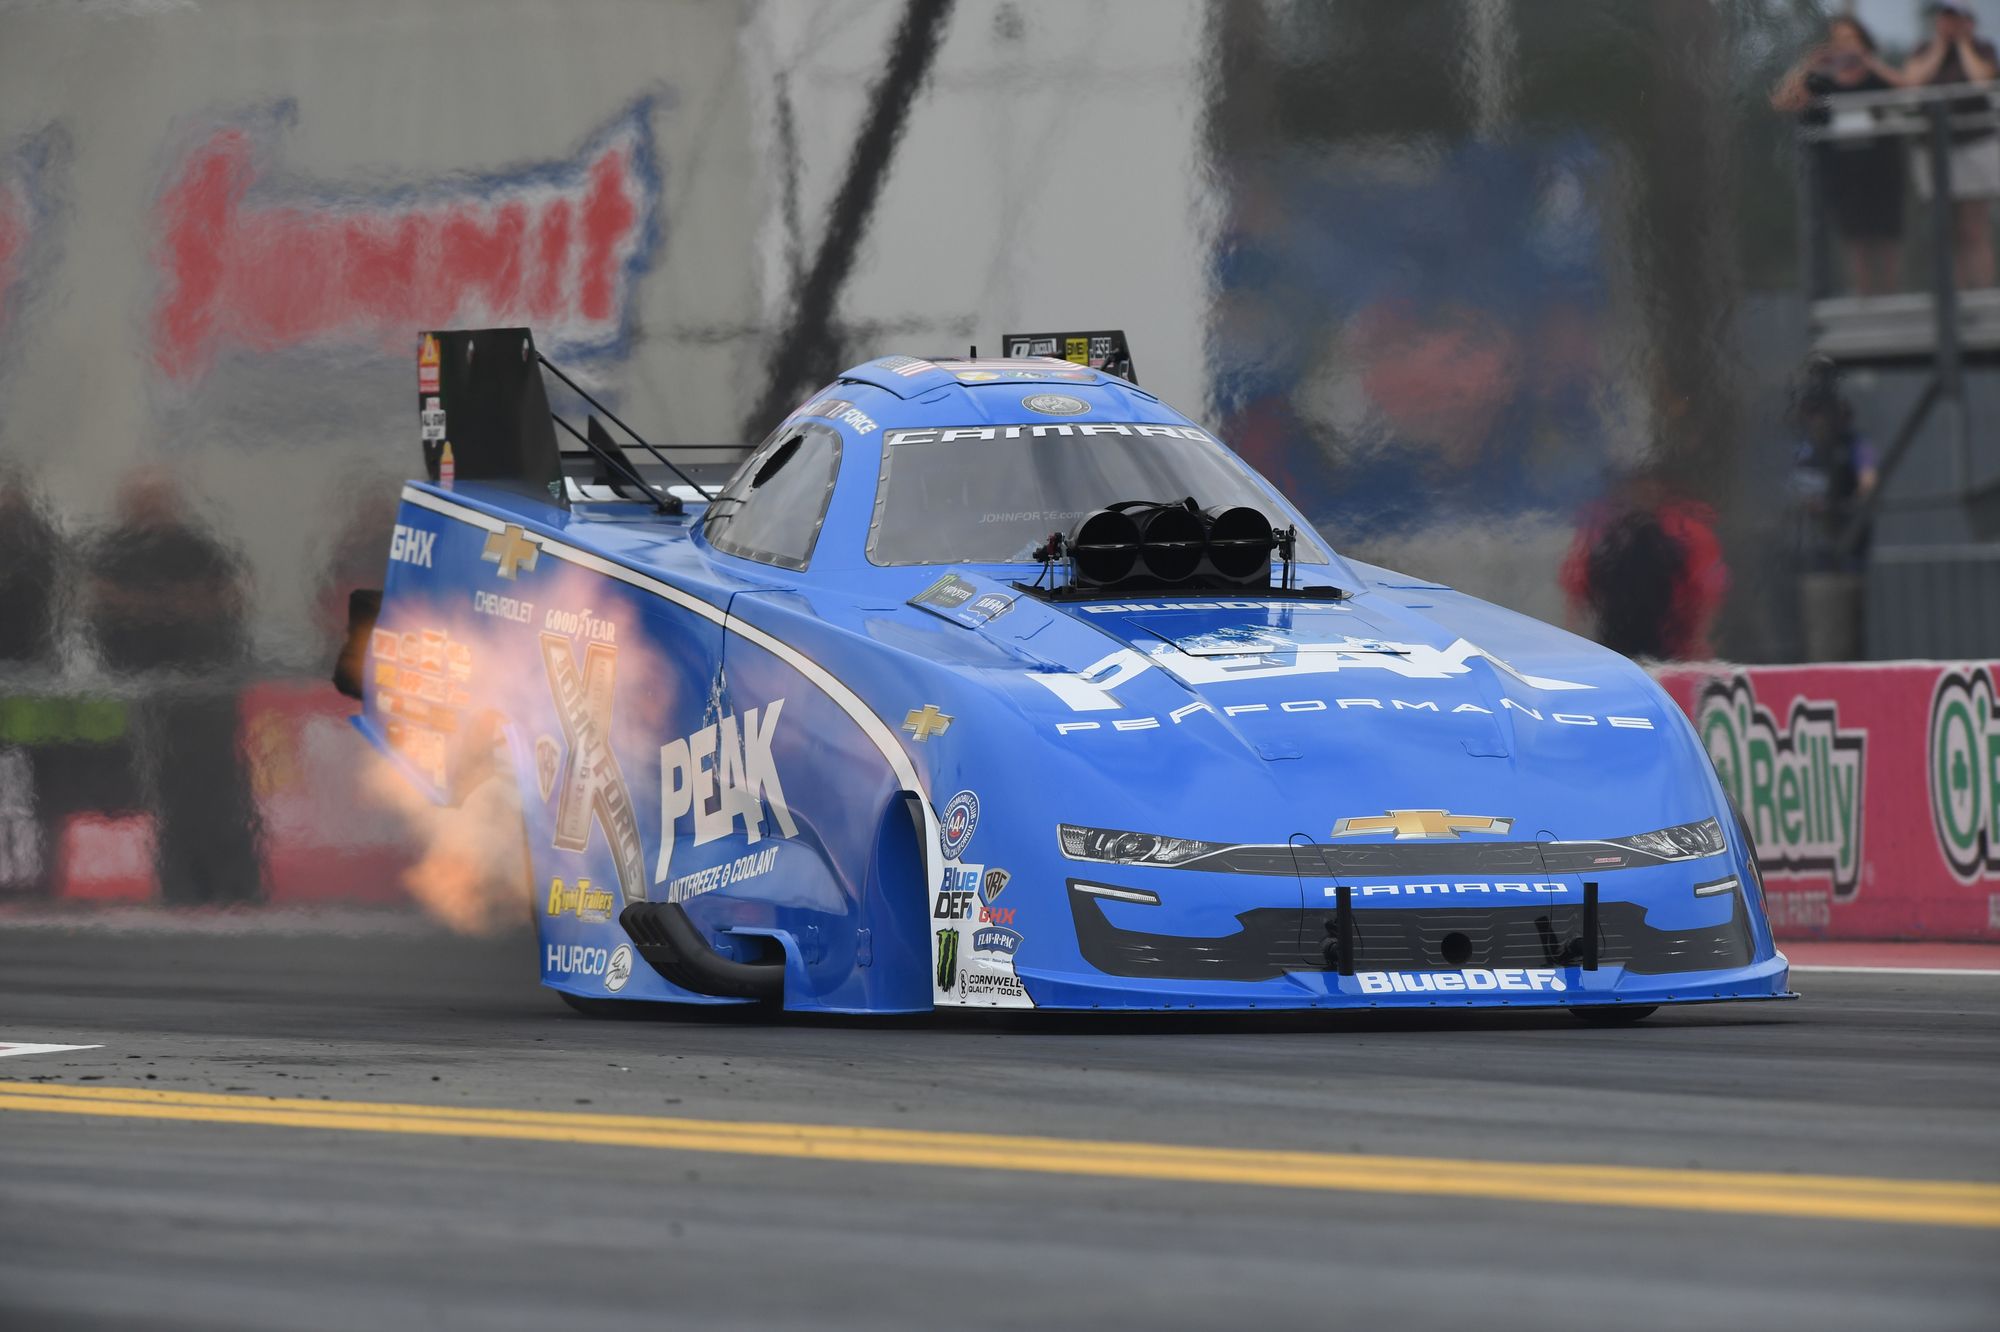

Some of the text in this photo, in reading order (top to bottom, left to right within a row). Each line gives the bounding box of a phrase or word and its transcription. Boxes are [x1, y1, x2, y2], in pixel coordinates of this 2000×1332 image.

[840, 408, 878, 435] FORCE
[889, 424, 1213, 446] CAMARO
[390, 524, 436, 568] GHX
[474, 590, 534, 624] CHEVROLET
[655, 698, 799, 884] PEAK
[1702, 701, 1853, 868] O'Reilly
[948, 815, 966, 832] AAA
[667, 864, 723, 904] ANTIFREEZE
[730, 846, 779, 884] COOLANT
[941, 867, 978, 891] Blue
[1324, 882, 1568, 897] CAMARO
[933, 892, 975, 919] DEF
[547, 944, 607, 975] HURCO
[969, 974, 1021, 988] CORNWELL
[997, 987, 1022, 997] TOOLS
[1356, 968, 1556, 994] BlueDEF
